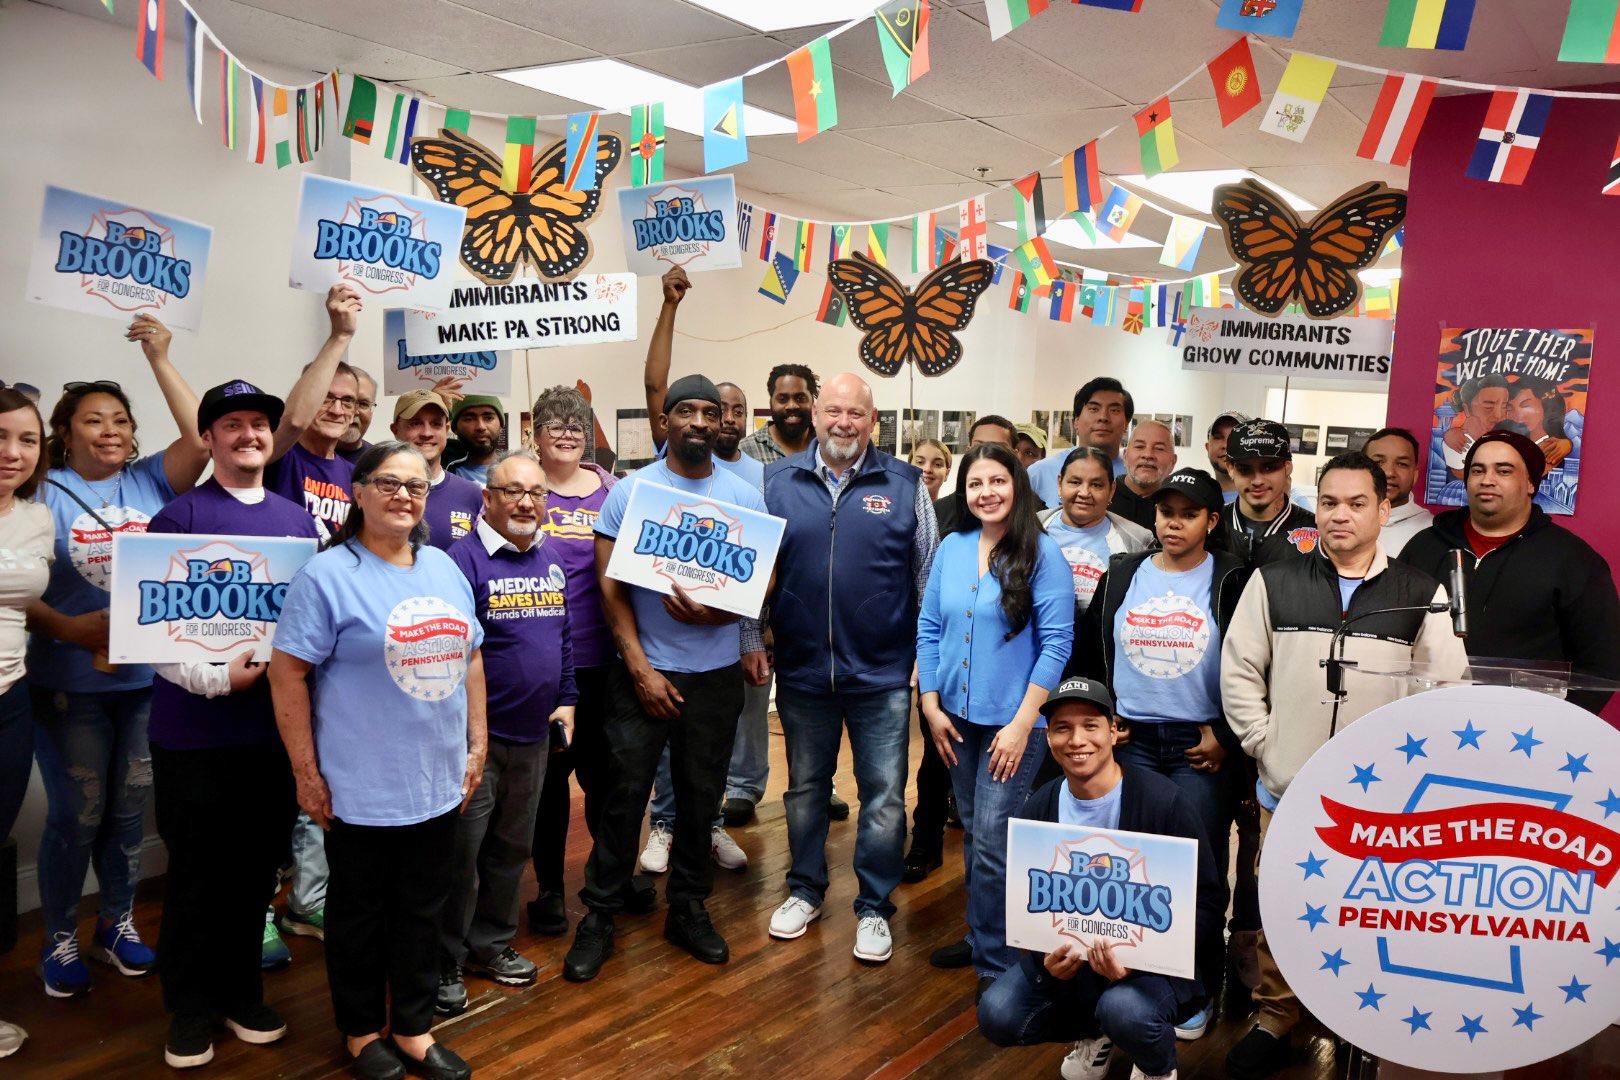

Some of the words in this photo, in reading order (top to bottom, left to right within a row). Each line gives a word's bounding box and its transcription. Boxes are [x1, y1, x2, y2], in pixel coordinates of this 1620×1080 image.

[655, 197, 694, 218] BOB
[360, 207, 412, 237] BOB
[633, 210, 725, 251] BROOKS
[105, 220, 161, 253] BOB
[314, 219, 442, 279] BROOKS
[669, 243, 700, 256] CONGRESS
[55, 231, 191, 298] BROOKS
[353, 264, 364, 276] FOR
[365, 265, 404, 284] CONGRESS
[97, 279, 110, 292] FOR
[111, 281, 156, 302] CONGRESS
[450, 282, 588, 308] IMMIGRANTS
[438, 321, 498, 344] MAKE
[505, 319, 529, 339] PA
[536, 312, 620, 337] STRONG
[1220, 320, 1352, 345] IMMIGRANTS
[1462, 328, 1576, 361] TOGETHER
[434, 366, 467, 375] CONGRESS
[1183, 346, 1242, 365] GROW
[1249, 349, 1391, 374] COMMUNITIES
[1456, 357, 1489, 385] WE
[1491, 353, 1525, 374] ARE
[1525, 356, 1570, 382] HOME
[224, 382, 257, 397] SEIU
[1240, 437, 1275, 447] Supreme
[304, 476, 343, 500] UNION
[1171, 475, 1196, 484] NYC
[304, 491, 351, 526] TRON
[451, 511, 471, 520] 32BJ
[83, 532, 108, 540] MAKE
[679, 512, 729, 541] BOB
[634, 519, 757, 583] BROOKS
[187, 558, 251, 585] BOB
[665, 563, 676, 573] FOR
[677, 563, 715, 584] CONGRESS
[1079, 567, 1100, 578] ROAD
[488, 576, 559, 595] MEDICAI
[489, 593, 533, 609] SAVES
[535, 591, 564, 606] LIVES
[487, 610, 520, 620] Hands
[521, 609, 535, 618] Off
[536, 608, 565, 617] Medicaid
[1132, 616, 1157, 624] MAKE
[1174, 616, 1198, 627] ROAD
[186, 623, 198, 635] FOR
[201, 622, 251, 636] CONGRESS
[400, 626, 425, 638] MAKE
[425, 622, 442, 632] THE
[442, 623, 466, 634] ROAD
[402, 636, 464, 657] ACTION
[1130, 639, 1194, 648] PENNSYLVANIA
[401, 651, 464, 667] PENNSYLVANIA
[1061, 682, 1087, 690] VANS
[1350, 823, 1443, 849] MAKE
[1447, 818, 1516, 841] THE
[1519, 822, 1613, 867] ROAD
[1069, 851, 1130, 882] BOB
[1343, 856, 1595, 914] ACTION
[1027, 868, 1172, 933] BROOKS
[1067, 918, 1079, 930] FOR
[1081, 919, 1129, 939] CONGRESS
[1338, 906, 1591, 943] PENNSYLVANIA
